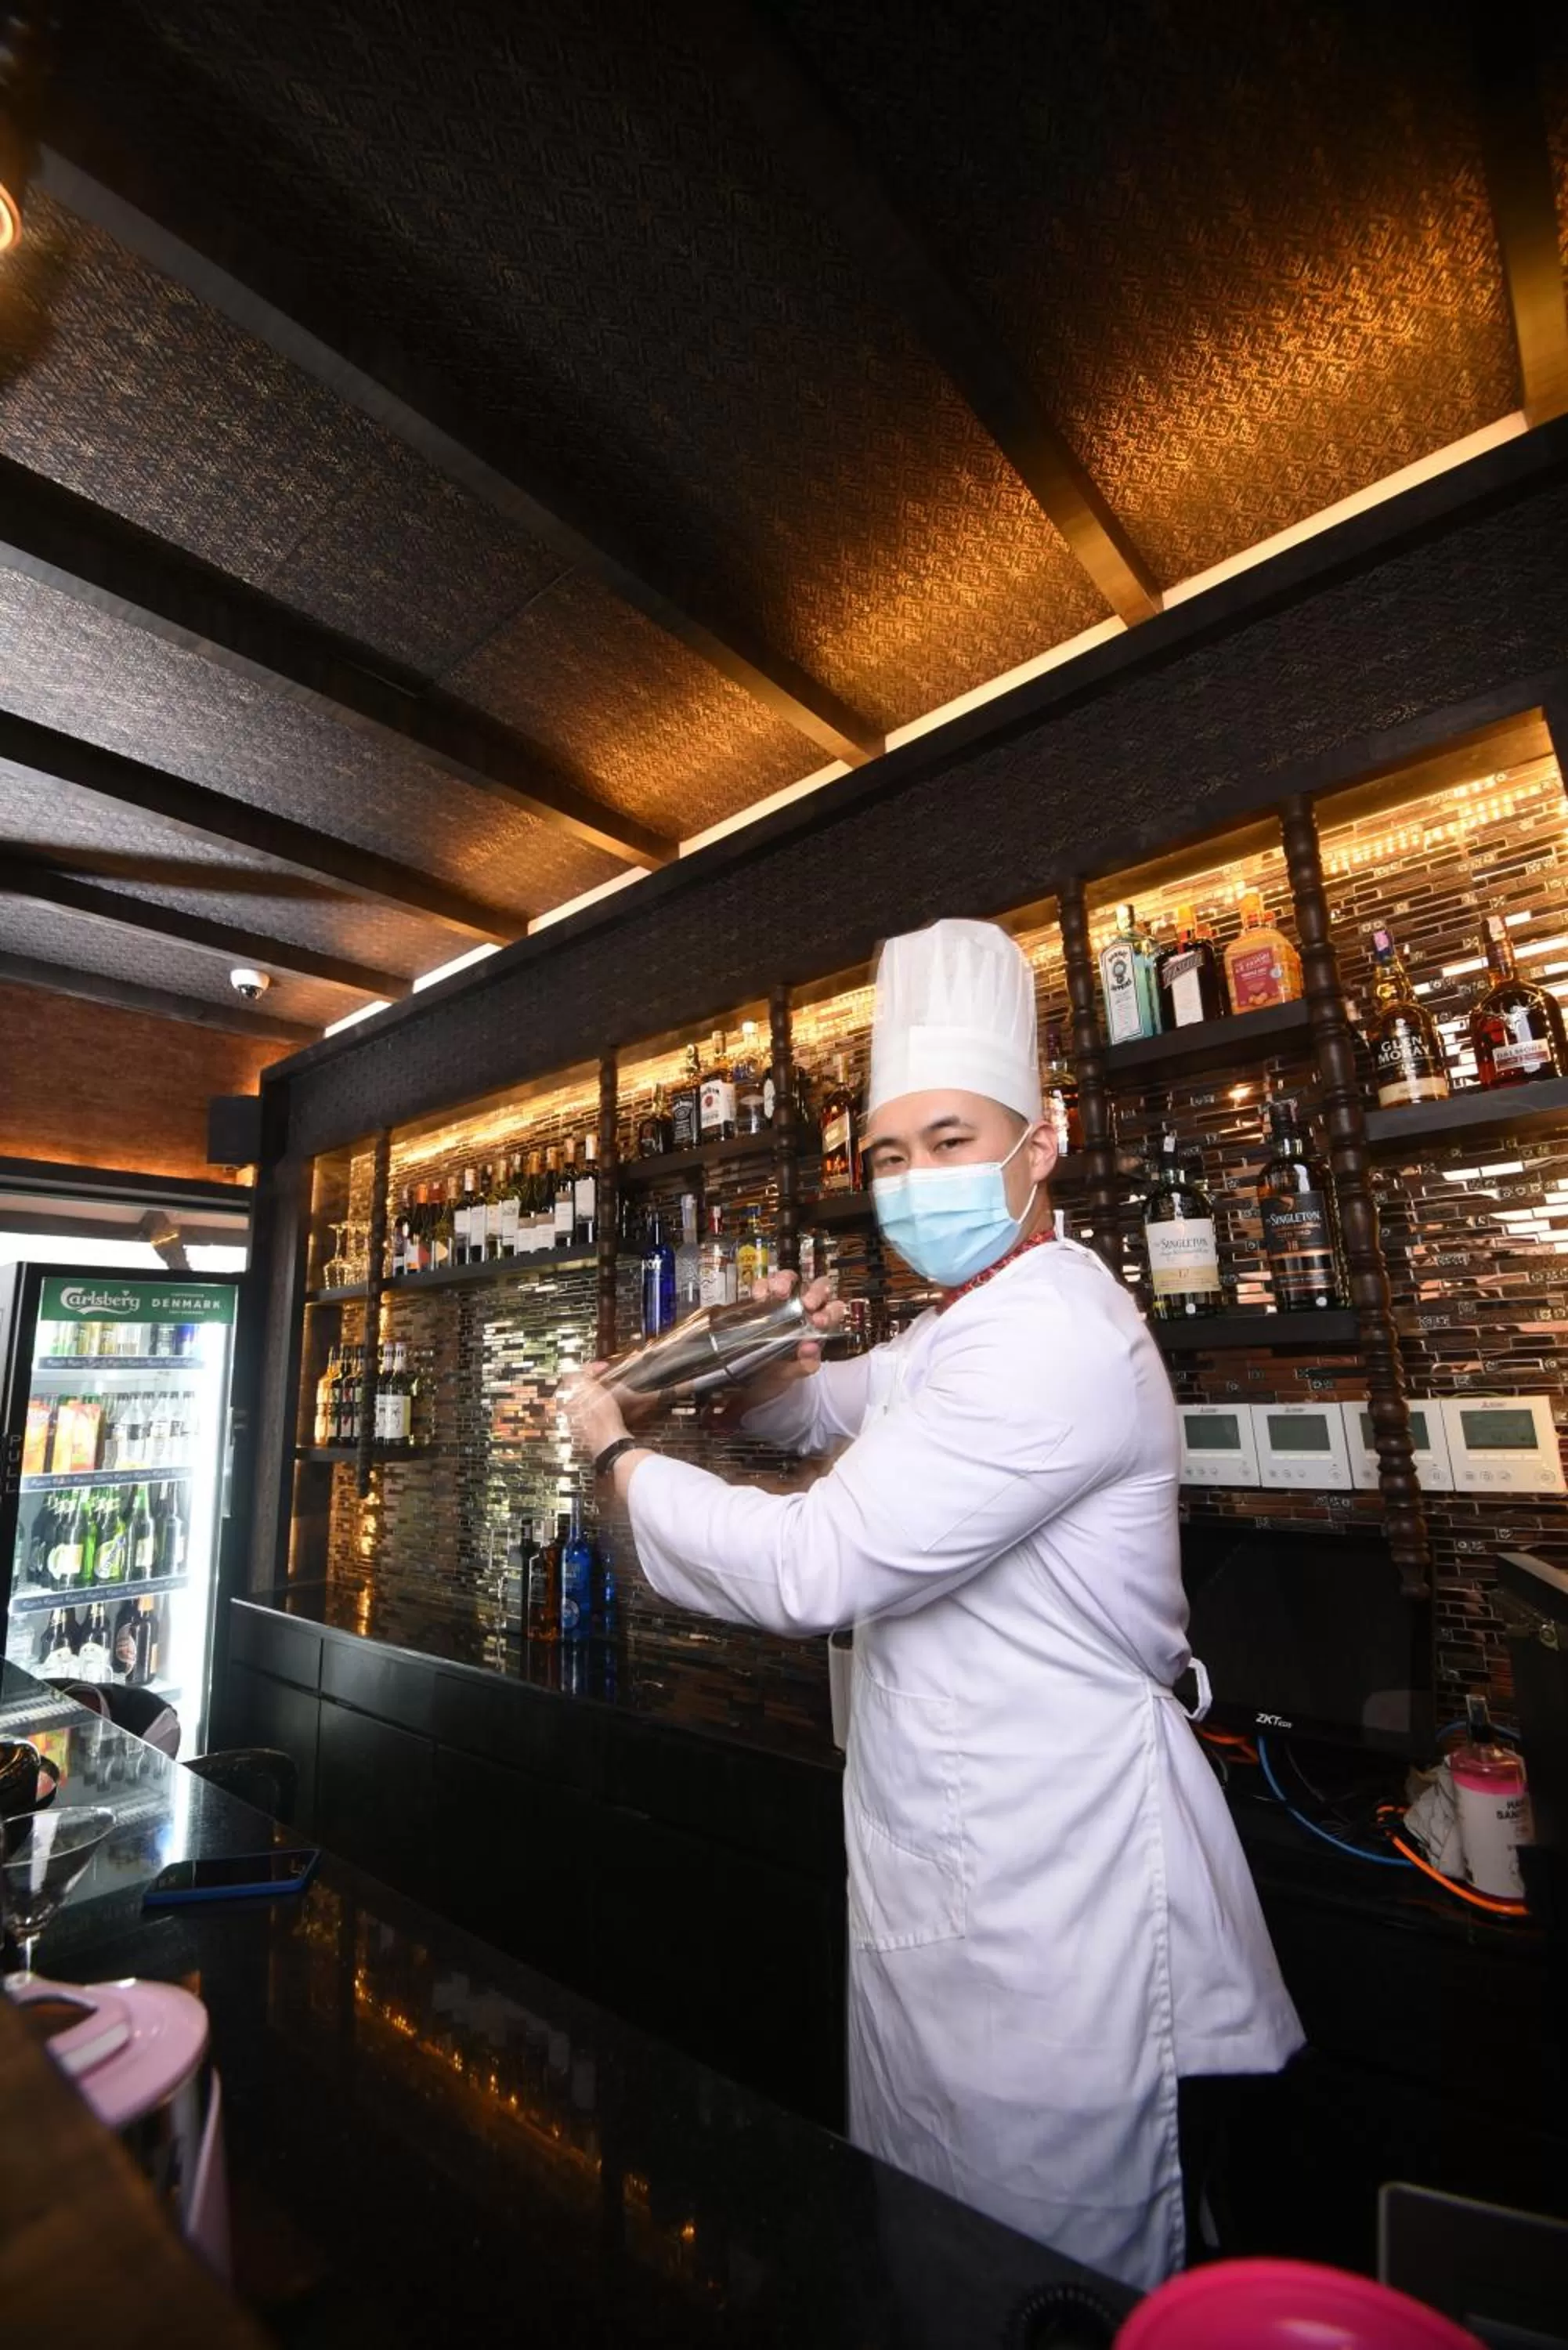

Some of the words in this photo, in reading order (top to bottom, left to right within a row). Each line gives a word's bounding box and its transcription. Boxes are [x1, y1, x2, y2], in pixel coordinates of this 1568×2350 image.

[1381, 1035, 1423, 1052] GLEN
[1270, 1210, 1322, 1227] SINGLETON
[60, 1287, 141, 1315] Carlsberg
[151, 1298, 222, 1310] DENMARK
[5, 1434, 21, 1493] PULL
